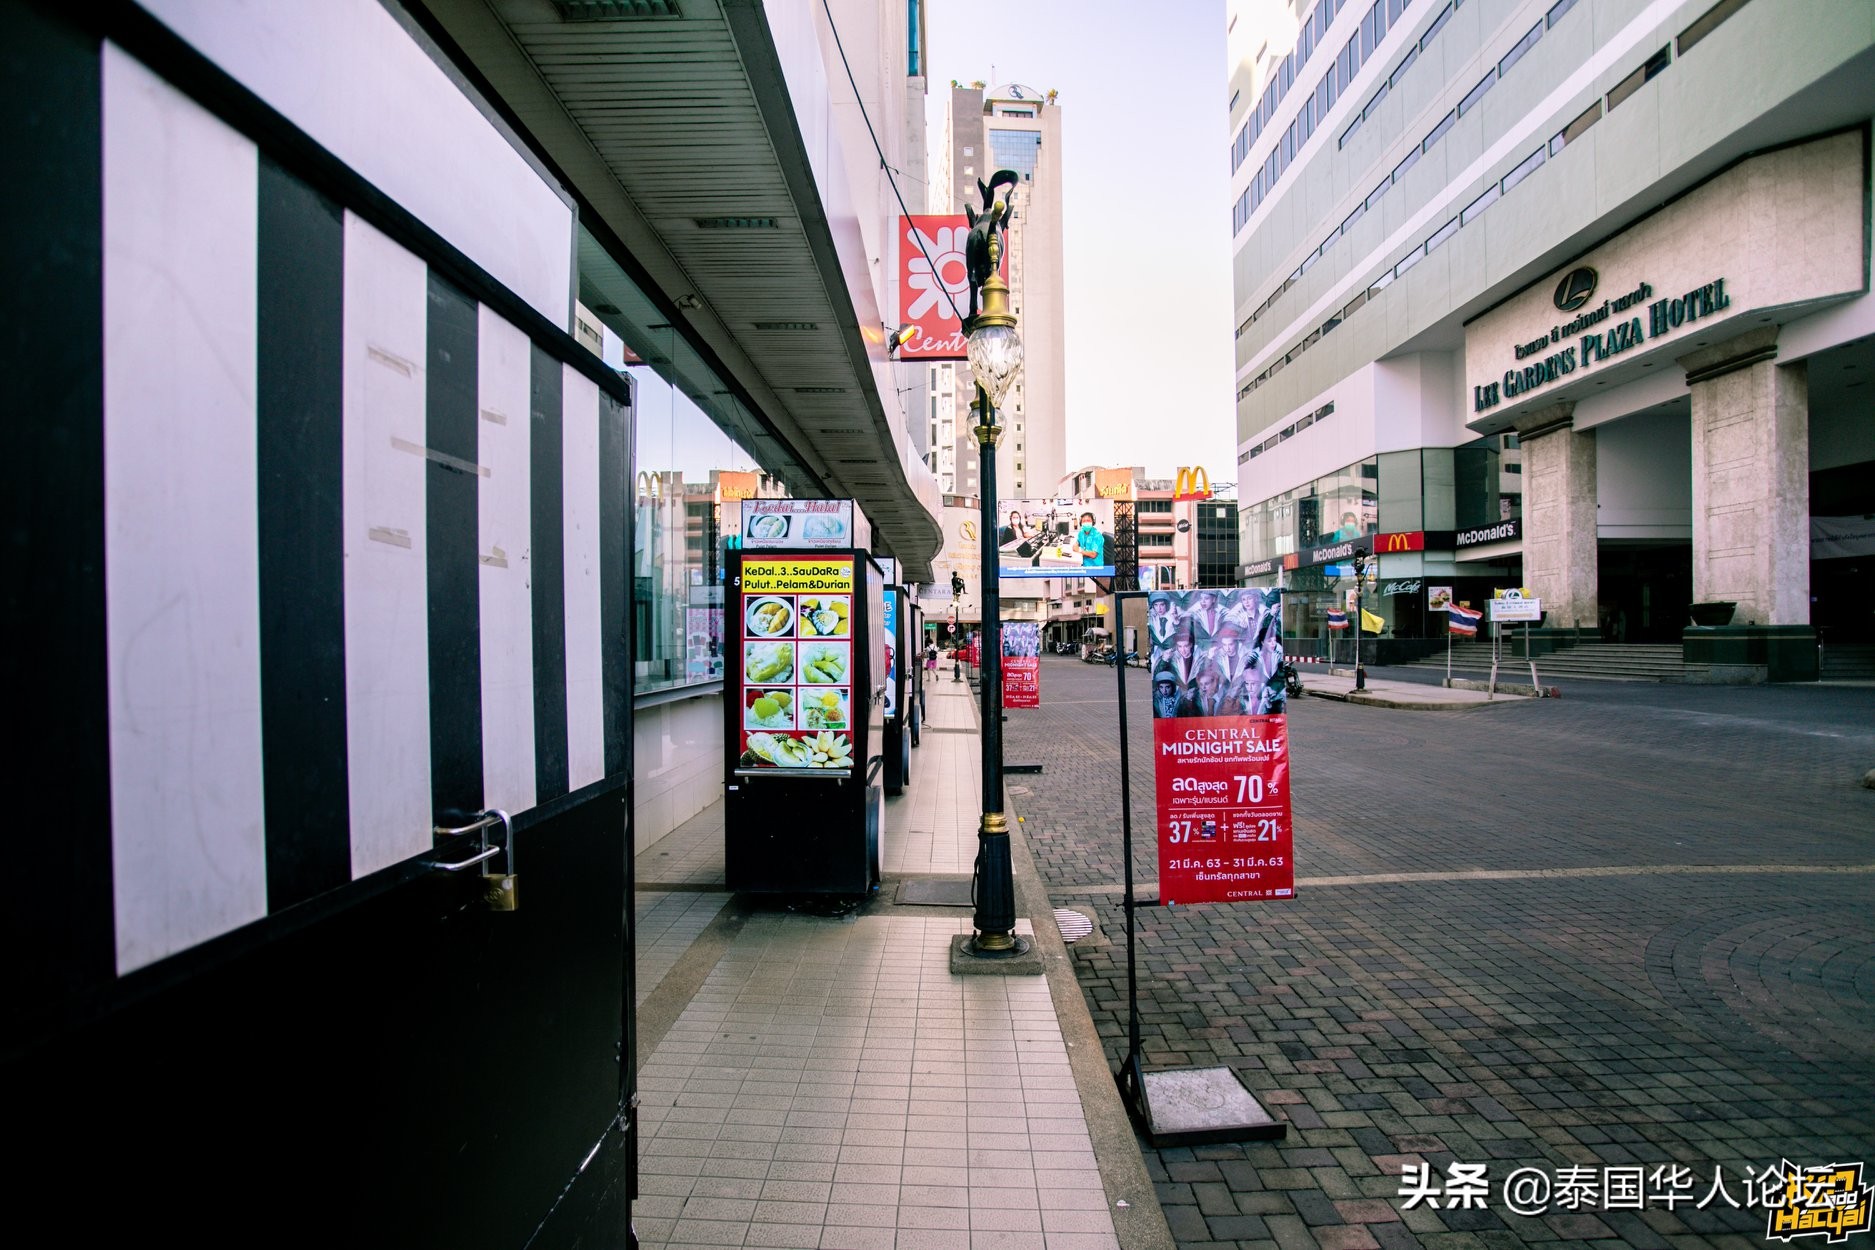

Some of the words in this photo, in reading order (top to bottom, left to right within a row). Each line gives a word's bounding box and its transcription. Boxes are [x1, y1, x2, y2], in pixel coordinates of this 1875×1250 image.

[1502, 348, 1576, 397] GARDENS
[1579, 317, 1644, 367] PLAZA
[1648, 278, 1729, 338] HOTEL
[1456, 523, 1515, 546] McDonald's
[1312, 543, 1352, 563] McDonald's
[1244, 560, 1272, 577] McDonald's
[733, 576, 741, 586] 5
[1185, 728, 1260, 741] CENTRAL
[1162, 741, 1243, 755] MIDNIGHT
[1246, 739, 1280, 753] SALE
[1172, 777, 1228, 794] ลดสูงสุด
[1169, 860, 1180, 869] 21
[1206, 859, 1221, 868] 63
[1233, 859, 1244, 867] 31
[1269, 857, 1284, 866] 63
